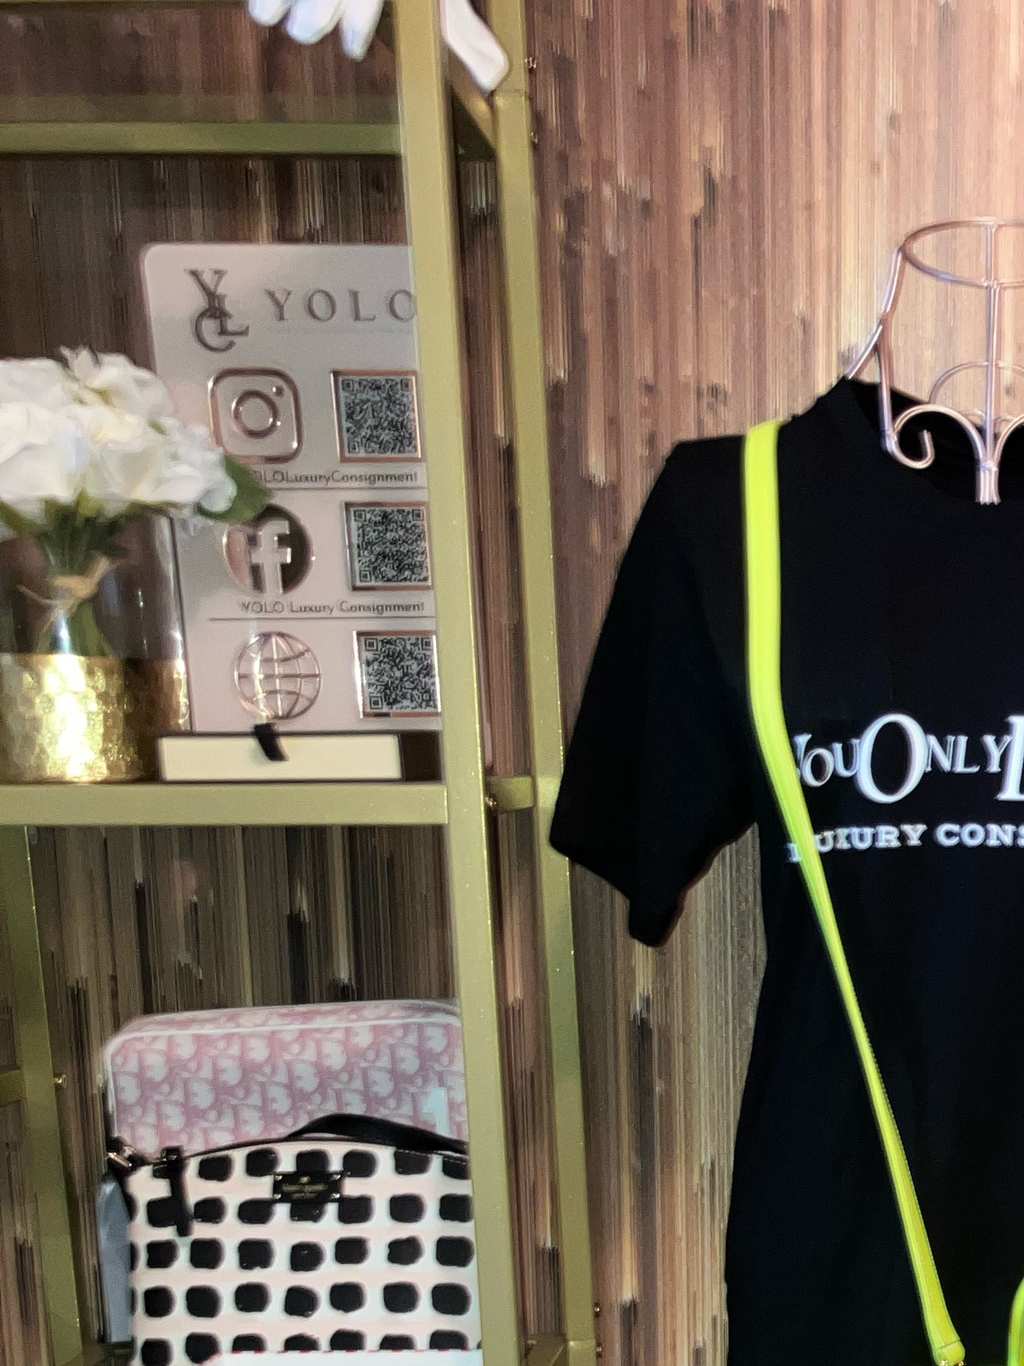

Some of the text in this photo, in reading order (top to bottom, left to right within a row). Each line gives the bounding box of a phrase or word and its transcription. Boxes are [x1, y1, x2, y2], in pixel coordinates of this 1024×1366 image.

[264, 288, 417, 323] YOLO
[290, 602, 334, 616] Luxury
[339, 601, 425, 616] Consignment
